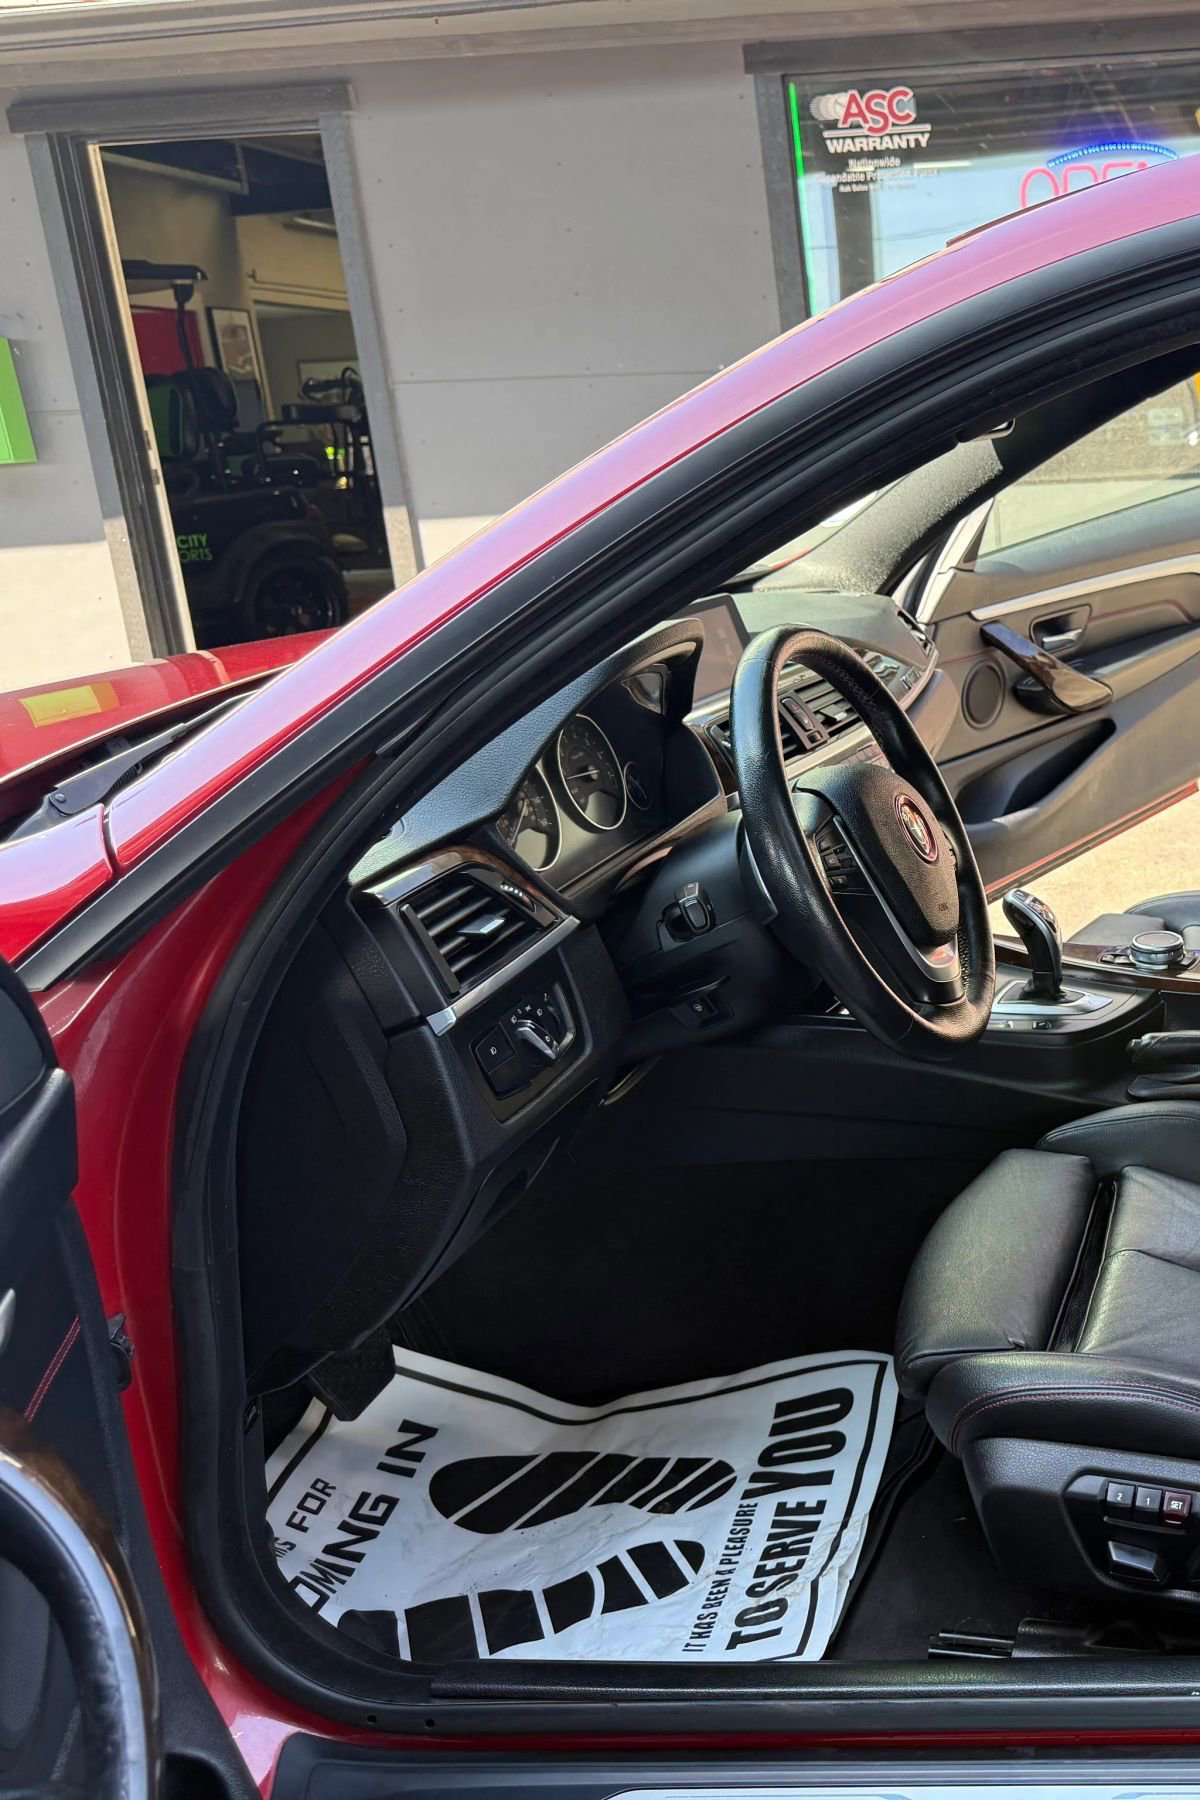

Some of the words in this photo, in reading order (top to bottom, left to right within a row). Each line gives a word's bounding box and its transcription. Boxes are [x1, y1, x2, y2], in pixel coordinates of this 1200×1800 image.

[838, 86, 914, 135] ASC
[825, 133, 930, 154] WARRANTY
[177, 533, 207, 549] CITY
[179, 548, 213, 563] ORTS
[740, 1387, 854, 1500] YOU
[285, 1478, 336, 1533] FOR
[288, 1491, 400, 1613] OMING
[376, 1419, 439, 1478] IN
[1116, 1492, 1122, 1501] 2
[1170, 1500, 1183, 1510] SET
[719, 1502, 758, 1567] PLEASURE
[745, 1499, 828, 1598] SERVE
[715, 1567, 736, 1577] A
[702, 1577, 731, 1611] BEEN
[690, 1612, 718, 1643] HAS
[725, 1597, 789, 1651] TO
[682, 1643, 706, 1652] IT
